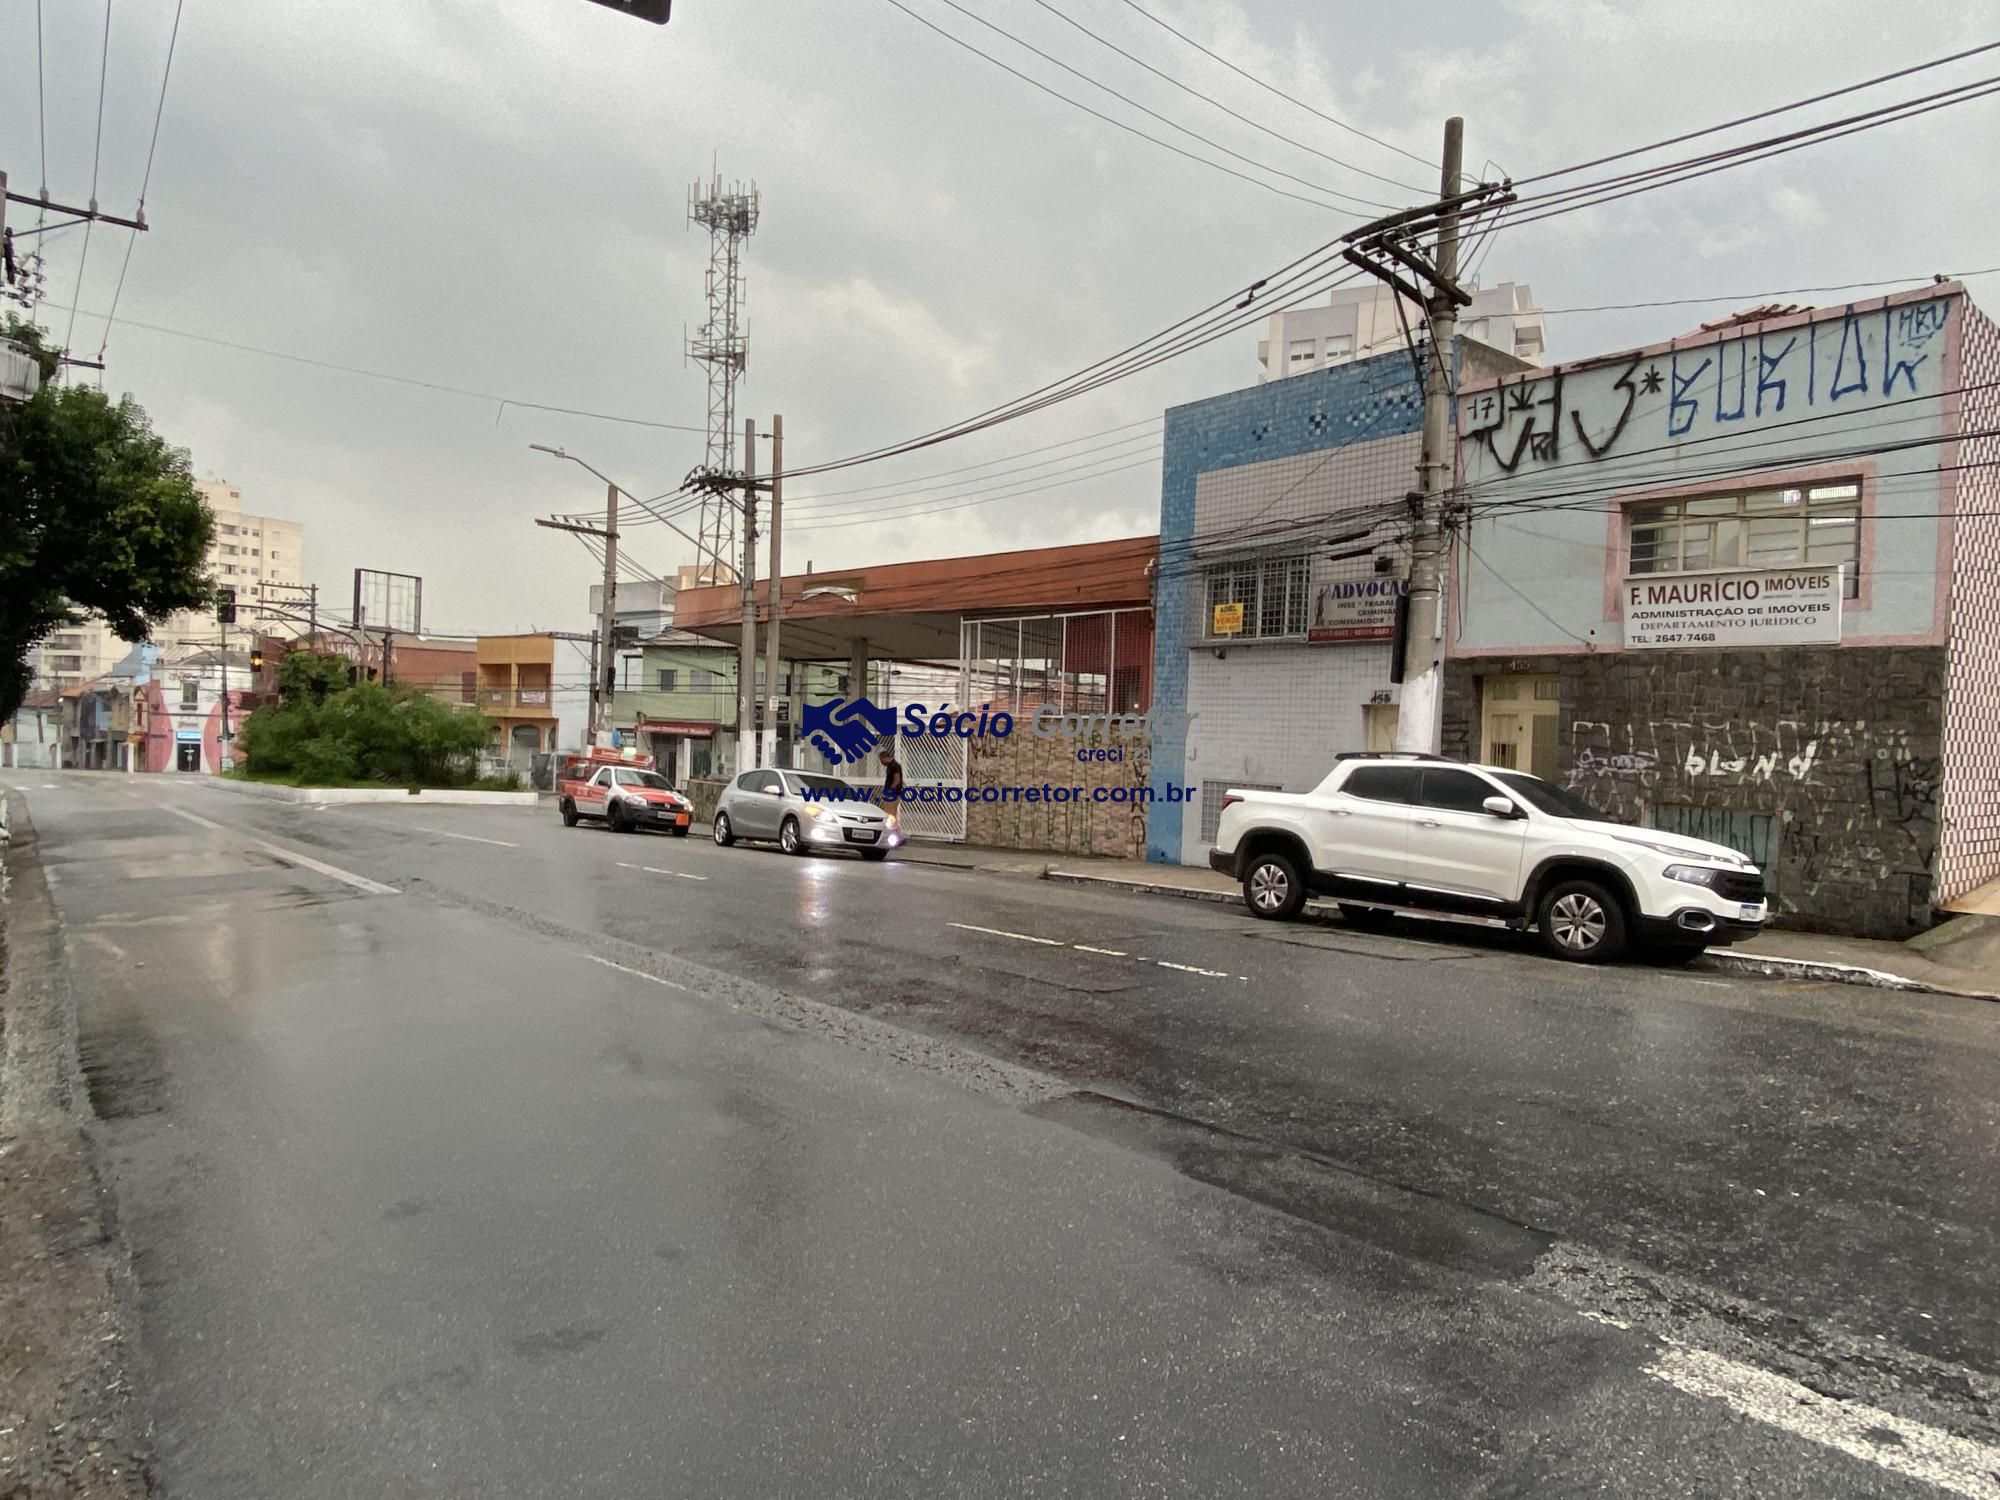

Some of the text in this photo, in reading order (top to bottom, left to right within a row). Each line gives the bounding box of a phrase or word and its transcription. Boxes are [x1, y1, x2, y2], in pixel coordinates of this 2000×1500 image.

[1331, 581, 1409, 599] ADVOCAC
[1631, 573, 1830, 605] F. MAURÍCIO IMÓVEIS
[1328, 618, 1385, 626] CONSUMIDOR
[1640, 618, 1746, 630] DEPARTAMENTO
